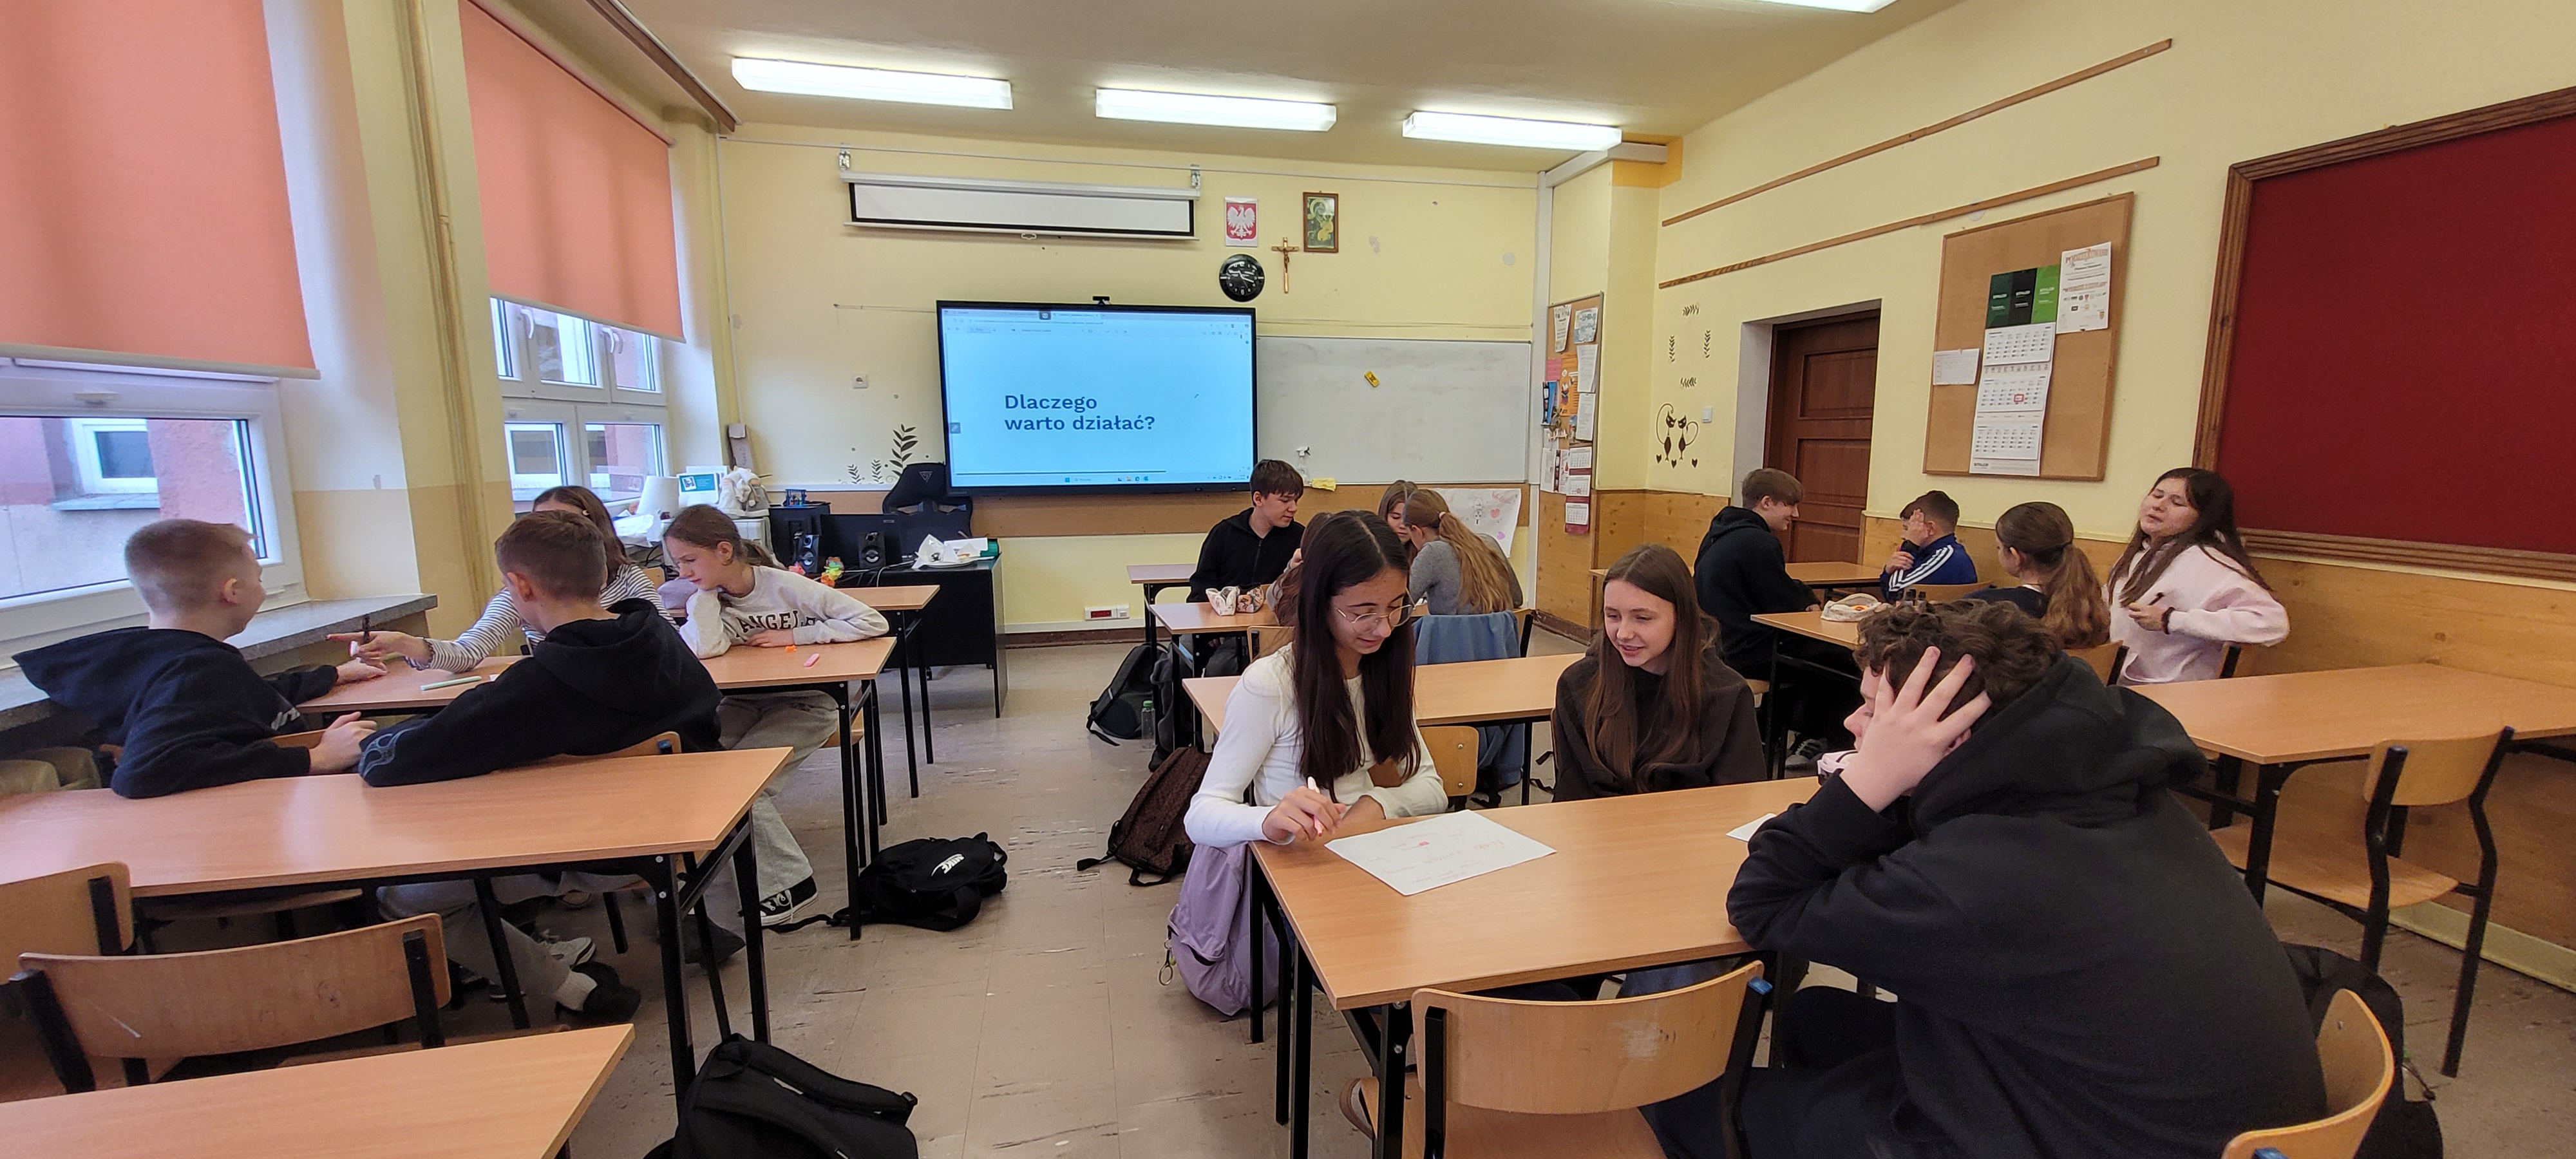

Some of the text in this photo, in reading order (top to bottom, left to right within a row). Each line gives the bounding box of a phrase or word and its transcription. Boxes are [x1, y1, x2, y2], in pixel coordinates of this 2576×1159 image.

[1004, 393, 1098, 414] Dlaczego
[1004, 414, 1156, 431] warto działać?
